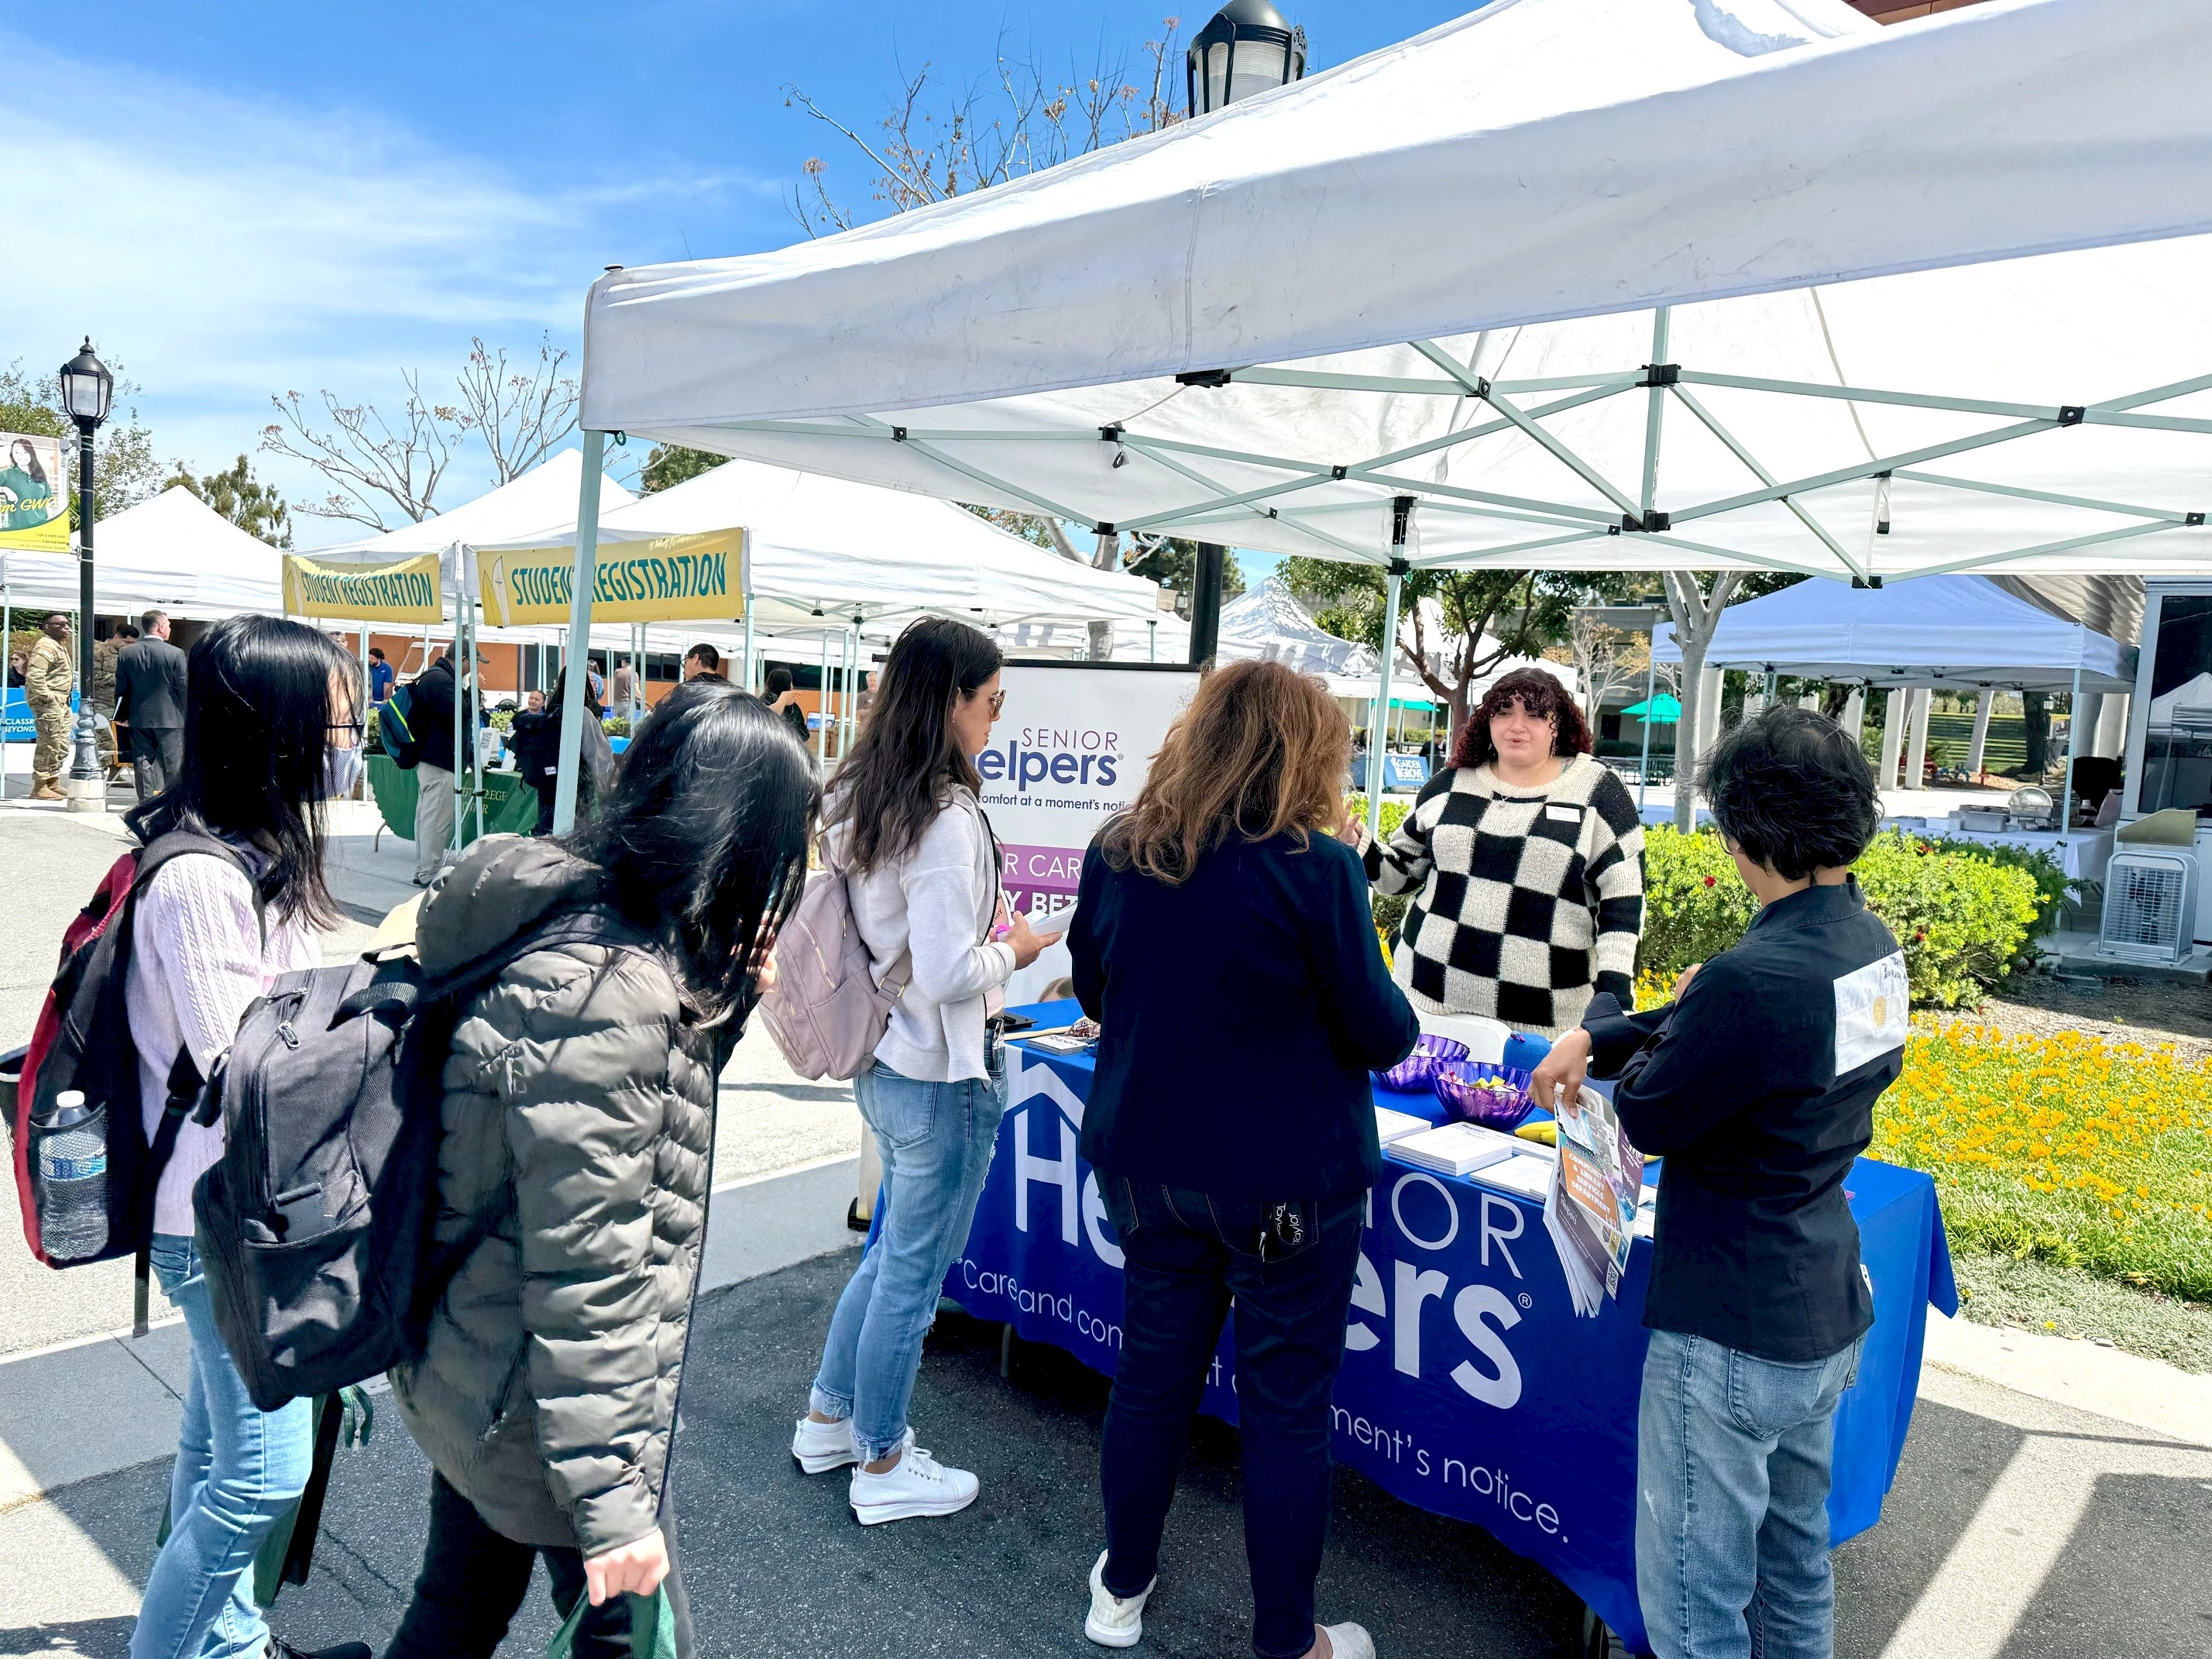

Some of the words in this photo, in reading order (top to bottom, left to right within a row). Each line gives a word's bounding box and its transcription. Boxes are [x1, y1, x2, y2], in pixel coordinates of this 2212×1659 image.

[302, 572, 342, 604] STUDENT
[342, 572, 434, 606] REGISTRATION
[512, 565, 575, 605] STUDEN
[1022, 728, 1118, 751] SENIOR
[971, 740, 1124, 792] elpers®
[1020, 795, 1032, 806] at
[1035, 799, 1042, 807] a
[1045, 799, 1100, 810] moment's
[1005, 853, 1018, 875] R
[1029, 854, 1081, 880] CAR
[1571, 1180, 1610, 1214] DEPARTMENT
[1576, 1175, 1604, 1200] SERVICES
[963, 1259, 1017, 1301] Care
[1018, 1293, 1072, 1324] and
[1444, 1458, 1568, 1544] notice.
